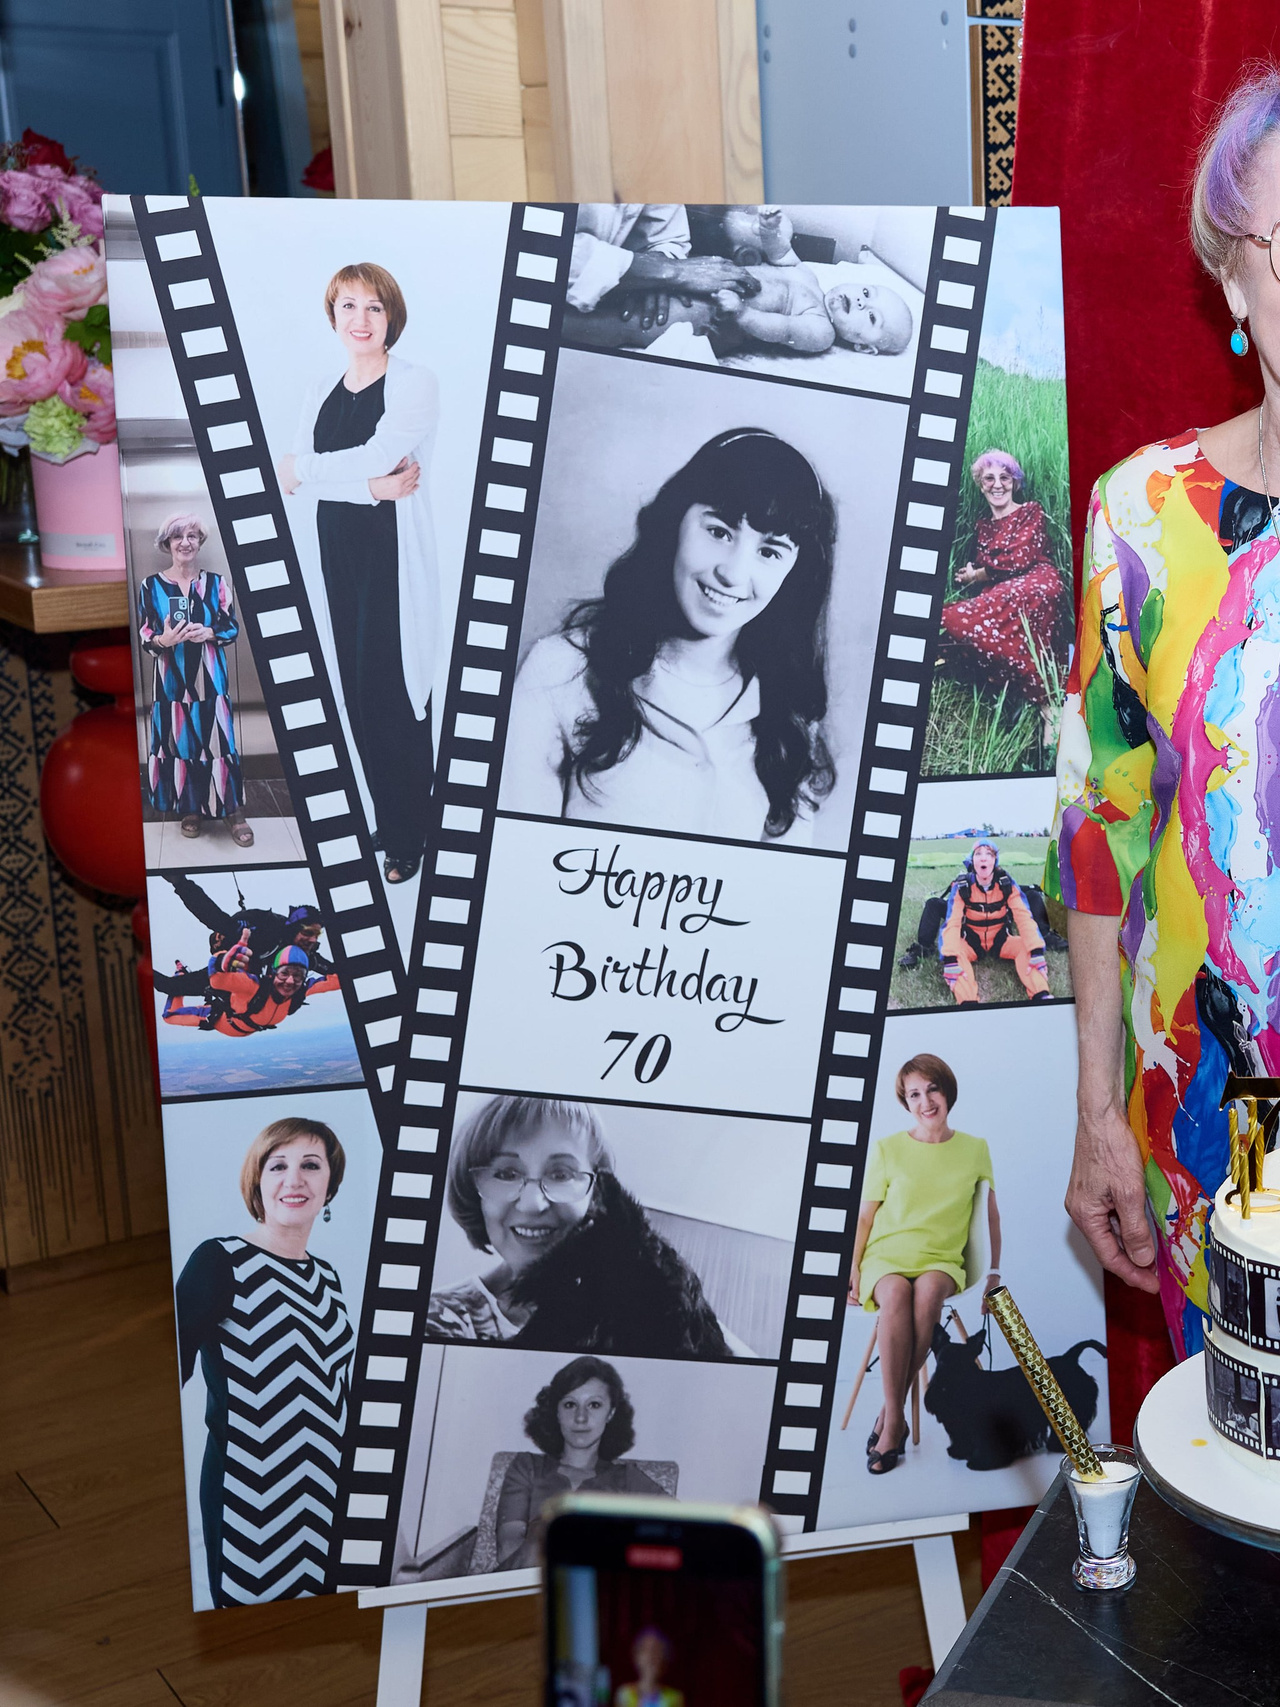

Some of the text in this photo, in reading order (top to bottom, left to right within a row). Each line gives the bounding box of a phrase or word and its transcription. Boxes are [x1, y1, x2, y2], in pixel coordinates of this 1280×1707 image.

[552, 844, 751, 934] Happy
[541, 940, 786, 1033] Birthday
[600, 1030, 672, 1084] 70
